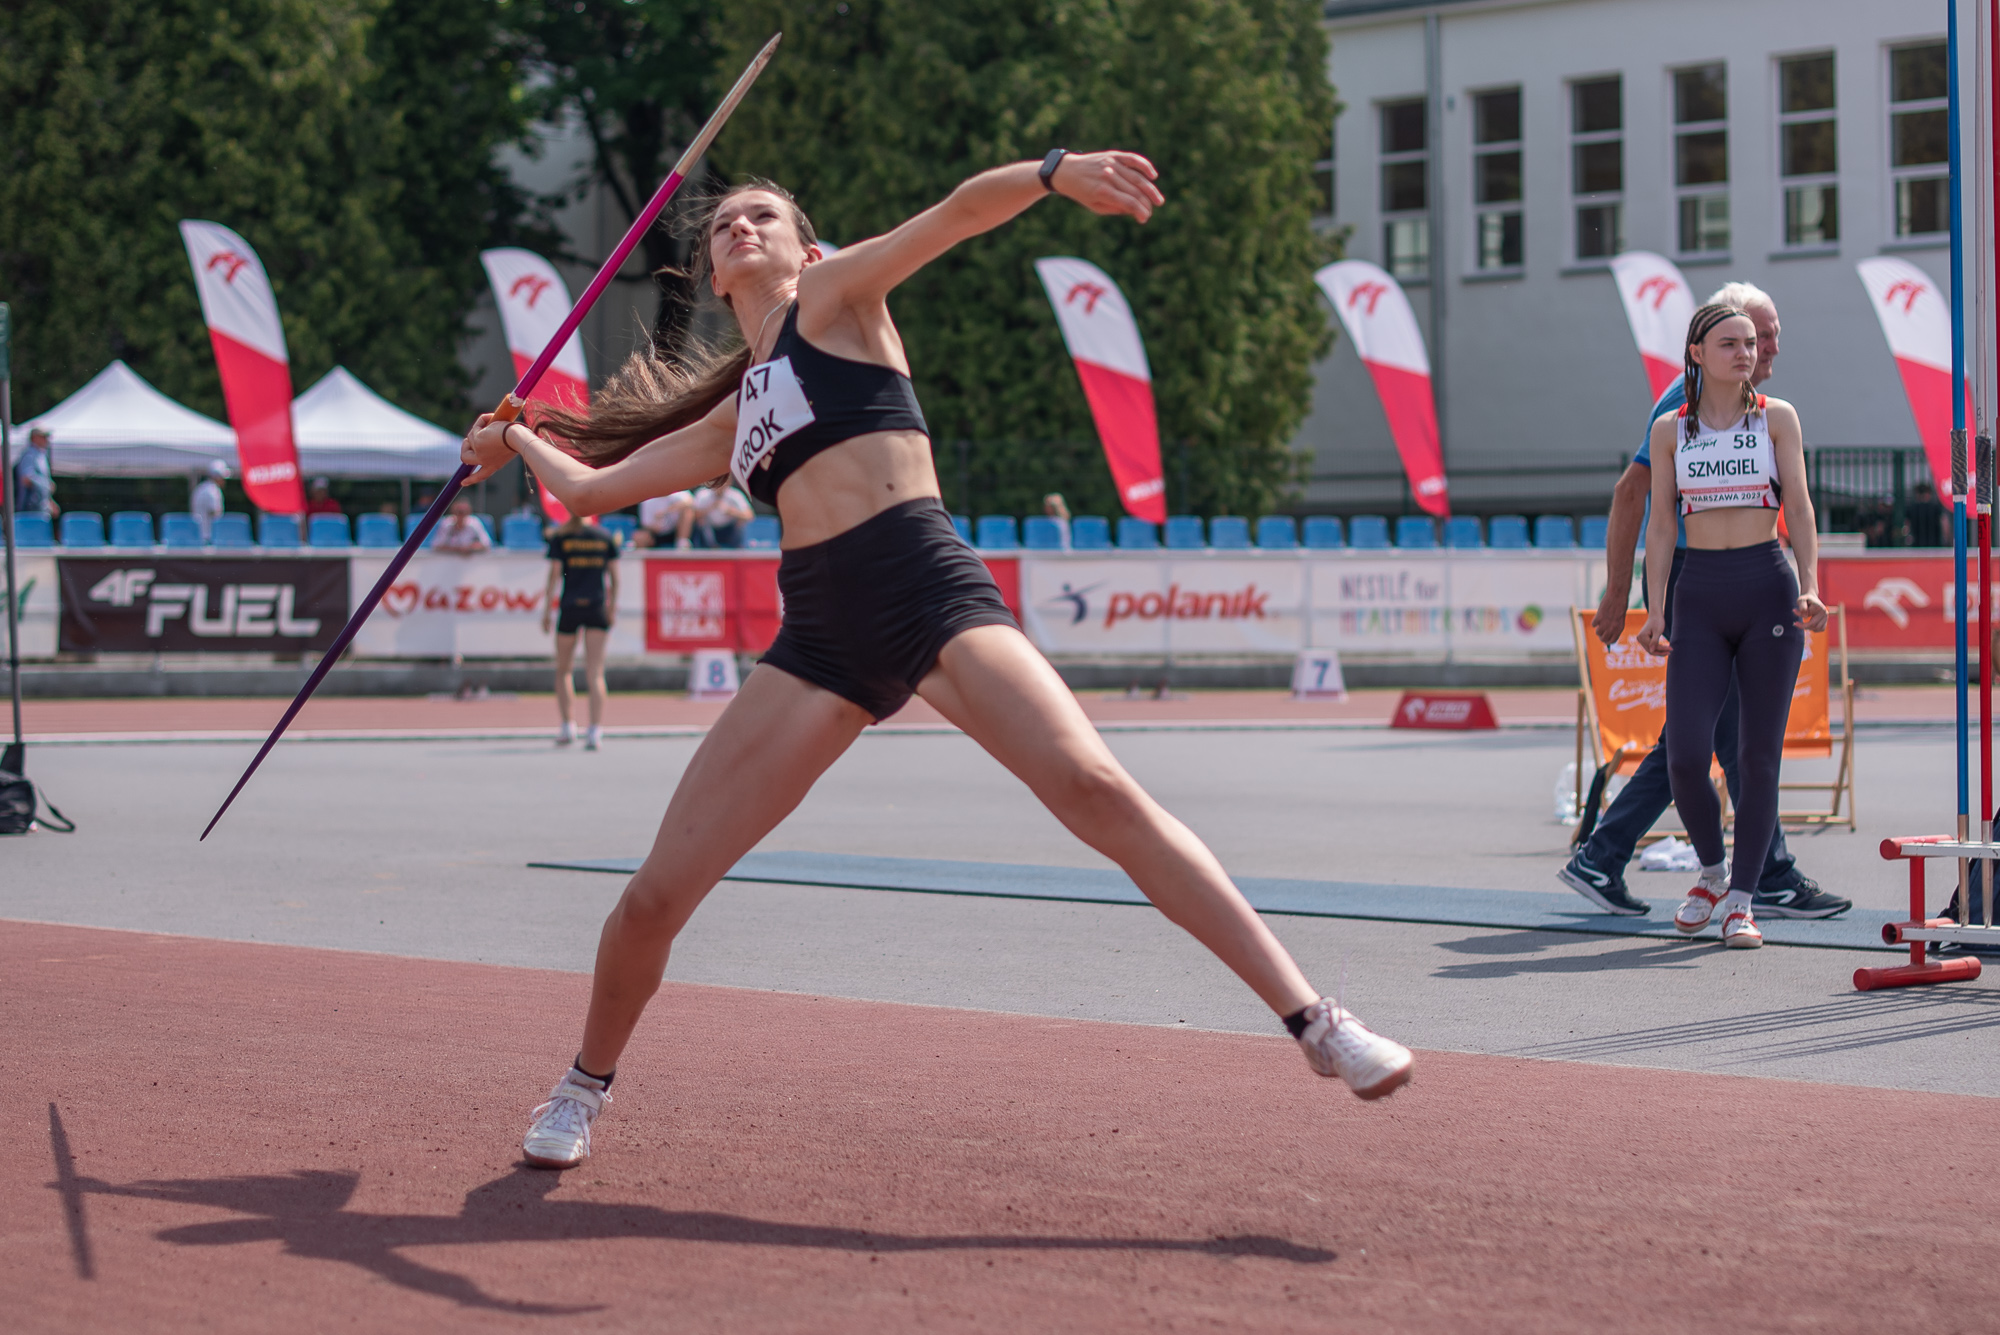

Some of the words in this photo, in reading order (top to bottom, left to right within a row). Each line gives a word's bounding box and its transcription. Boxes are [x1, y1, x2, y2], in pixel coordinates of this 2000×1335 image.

[746, 366, 771, 402] 47
[738, 408, 784, 476] KROK
[1733, 434, 1757, 449] 58
[1688, 458, 1759, 477] SZMIGIEL
[1690, 492, 1739, 502] WARSZAWA
[1741, 491, 1761, 500] 2023
[88, 569, 155, 606] 4F
[145, 583, 321, 637] FUEL
[1415, 579, 1439, 600] for
[1104, 583, 1269, 629] polanik
[1339, 607, 1454, 634] HEALTHIER
[1463, 607, 1510, 633] KIDS
[708, 660, 725, 688] 8
[1313, 660, 1330, 688] 7
